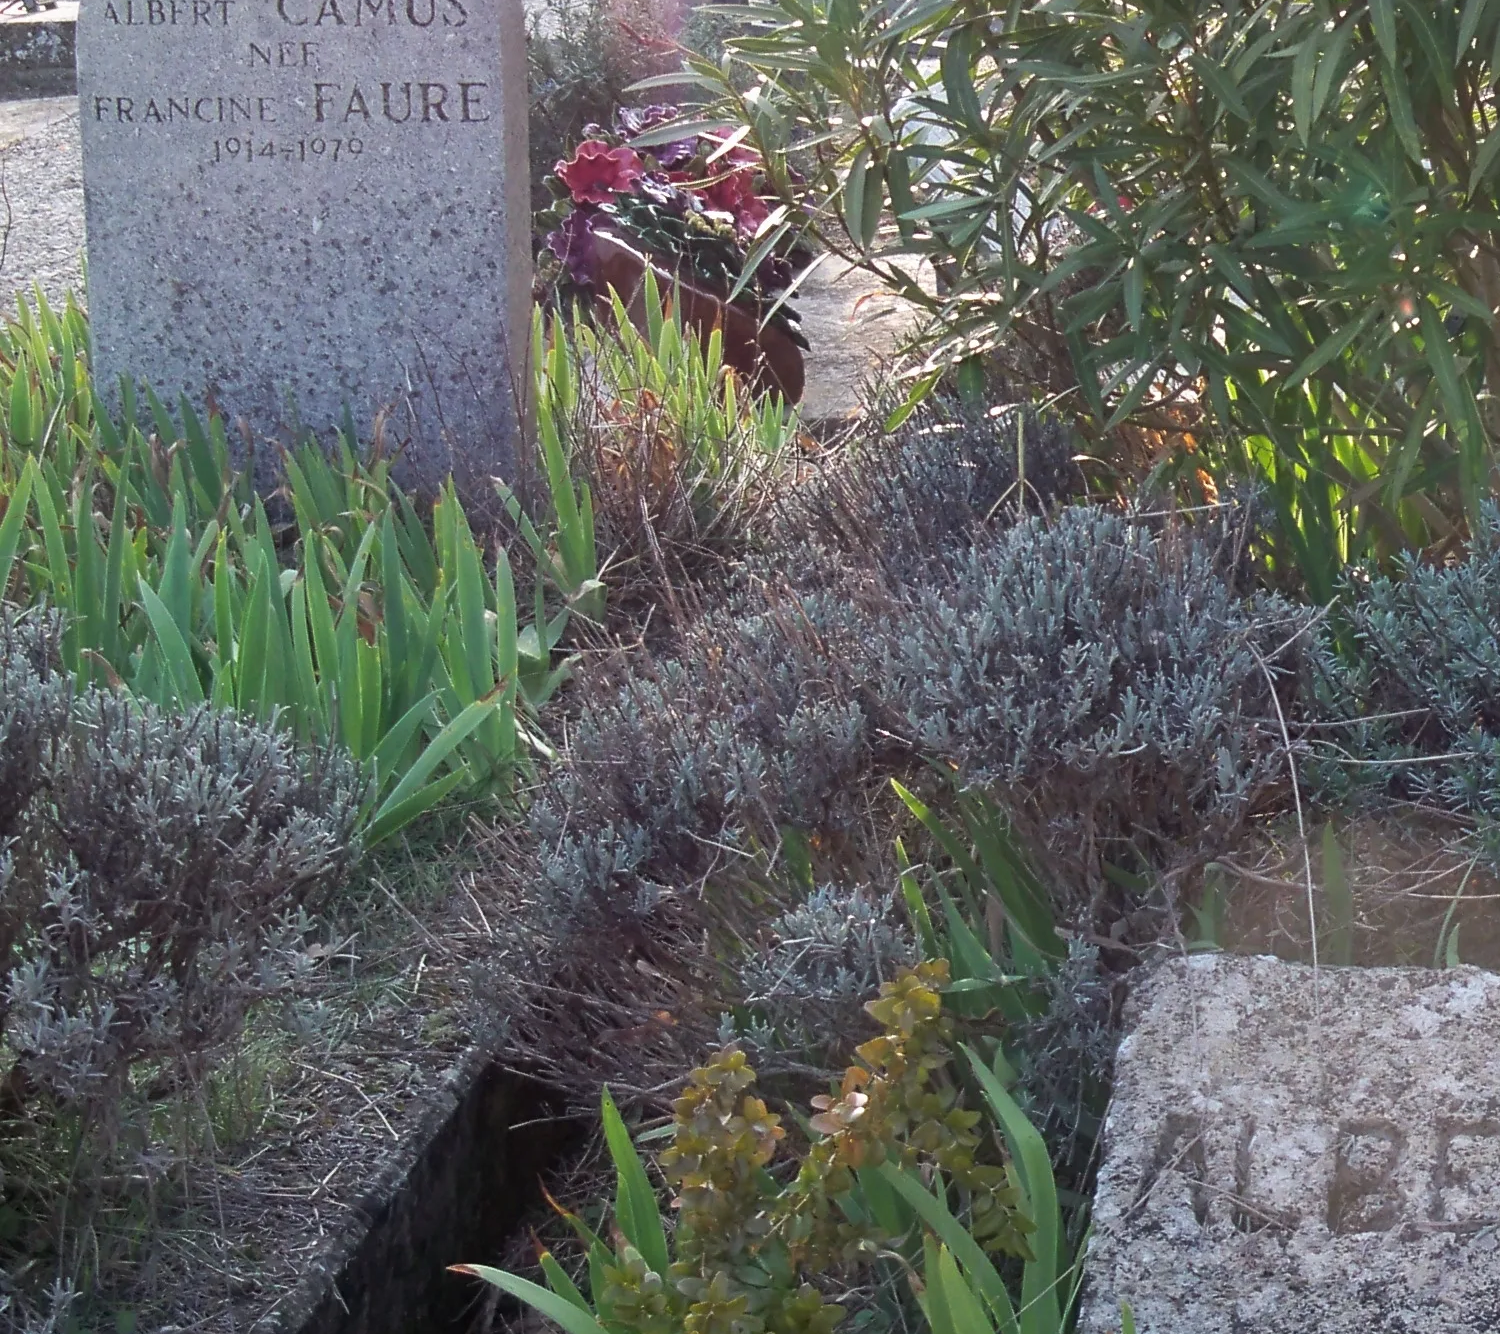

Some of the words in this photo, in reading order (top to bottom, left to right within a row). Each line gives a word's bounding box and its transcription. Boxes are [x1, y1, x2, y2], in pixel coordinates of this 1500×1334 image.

[94, 95, 279, 124] FRANCINE
[312, 81, 492, 124] FAURE
[212, 136, 365, 163] 1914-1979
